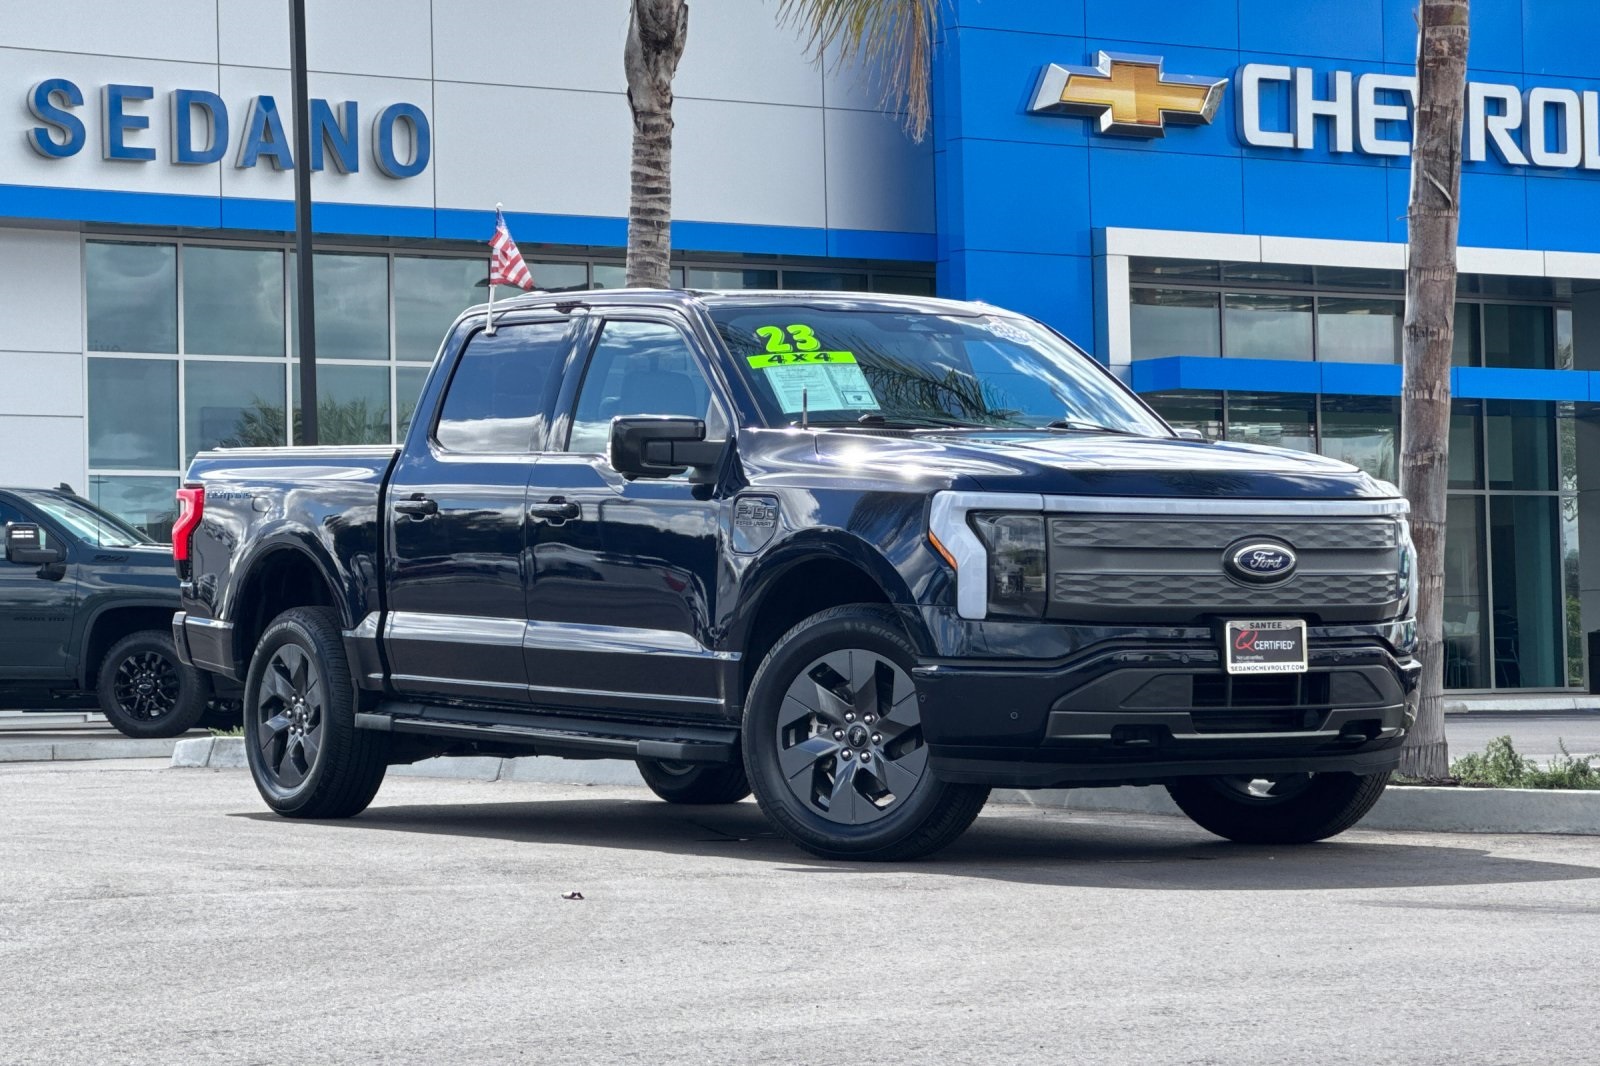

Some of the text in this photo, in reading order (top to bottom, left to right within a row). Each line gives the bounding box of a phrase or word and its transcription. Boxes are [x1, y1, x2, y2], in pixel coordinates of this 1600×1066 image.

[27, 78, 431, 180] SEDANO
[1236, 63, 1600, 170] CHEROL
[756, 324, 821, 353] 23
[736, 504, 776, 520] F-150
[1249, 551, 1284, 569] Ford
